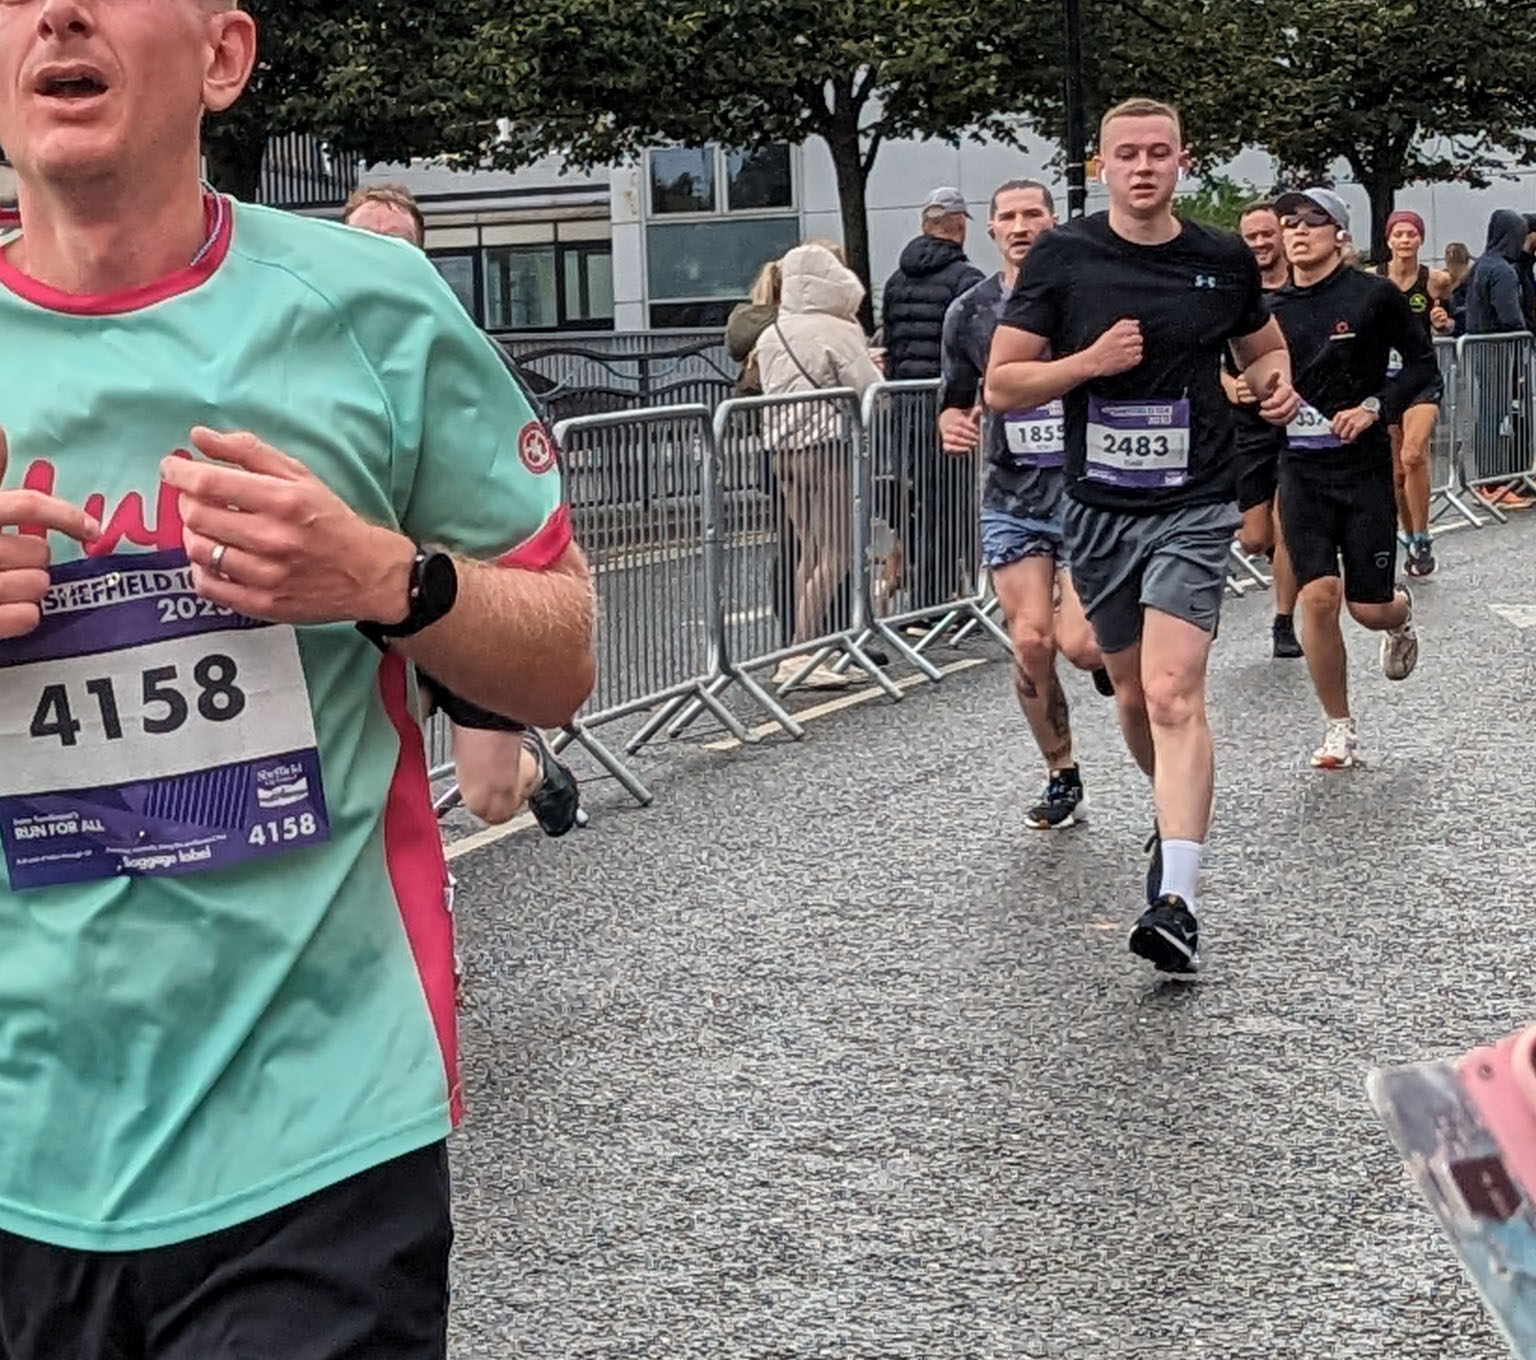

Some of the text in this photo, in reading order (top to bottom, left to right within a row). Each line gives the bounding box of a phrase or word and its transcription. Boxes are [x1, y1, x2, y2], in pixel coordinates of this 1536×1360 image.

[1103, 434, 1169, 457] 2483
[43, 572, 172, 611] SHEFFIELD
[30, 653, 246, 747] 4158
[14, 824, 47, 840] RUN
[48, 820, 79, 836] FOR
[81, 818, 106, 833] ALL
[248, 812, 316, 846] 4158
[178, 844, 212, 862] label
